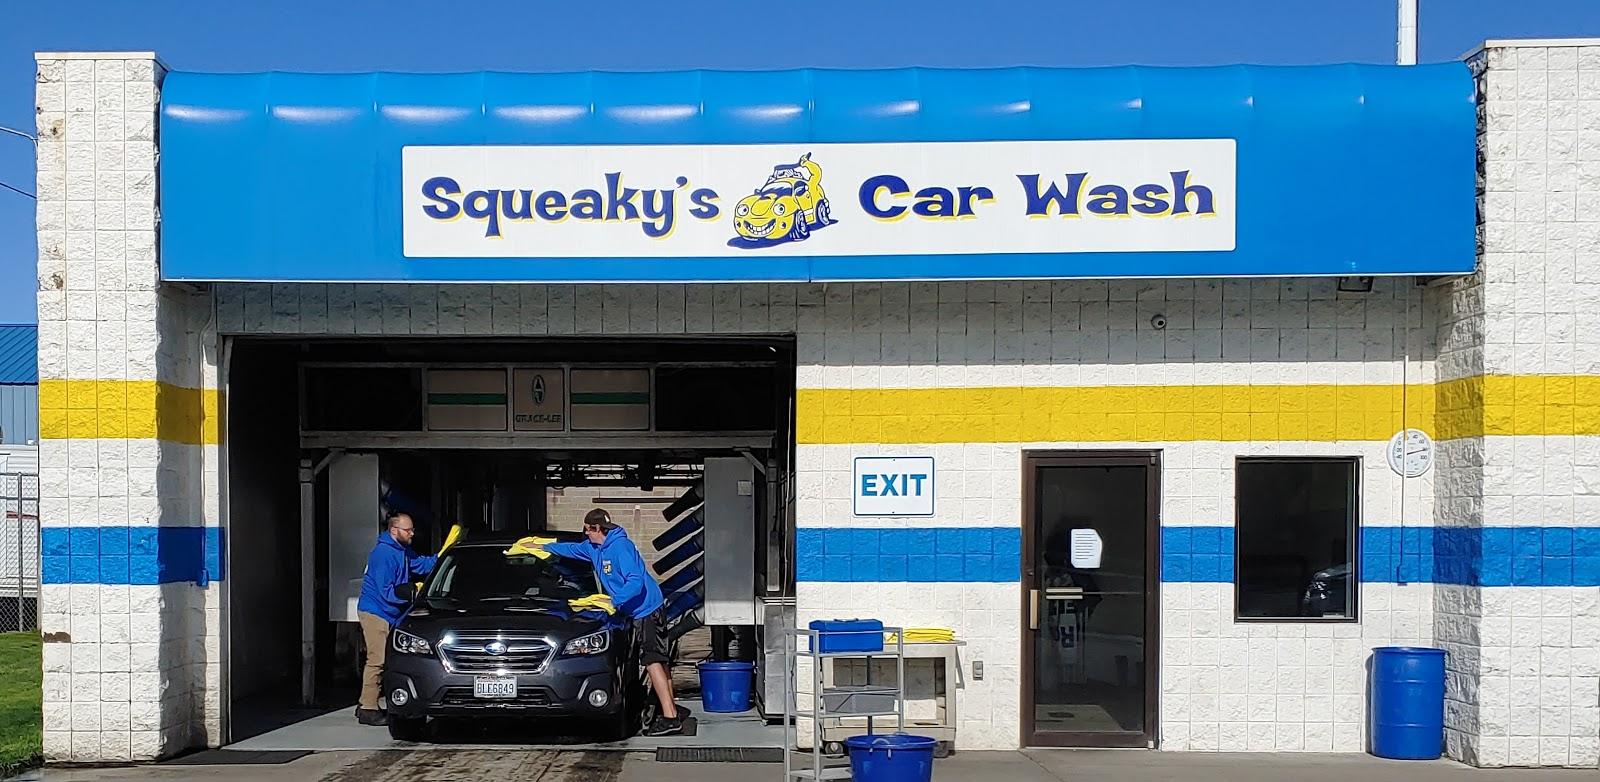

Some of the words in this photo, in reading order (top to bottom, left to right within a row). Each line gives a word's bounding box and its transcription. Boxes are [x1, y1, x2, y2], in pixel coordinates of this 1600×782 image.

[421, 171, 721, 240] Squeaky's
[858, 174, 996, 224] Car
[1015, 169, 1217, 221] Wash
[861, 473, 927, 497] EXIT
